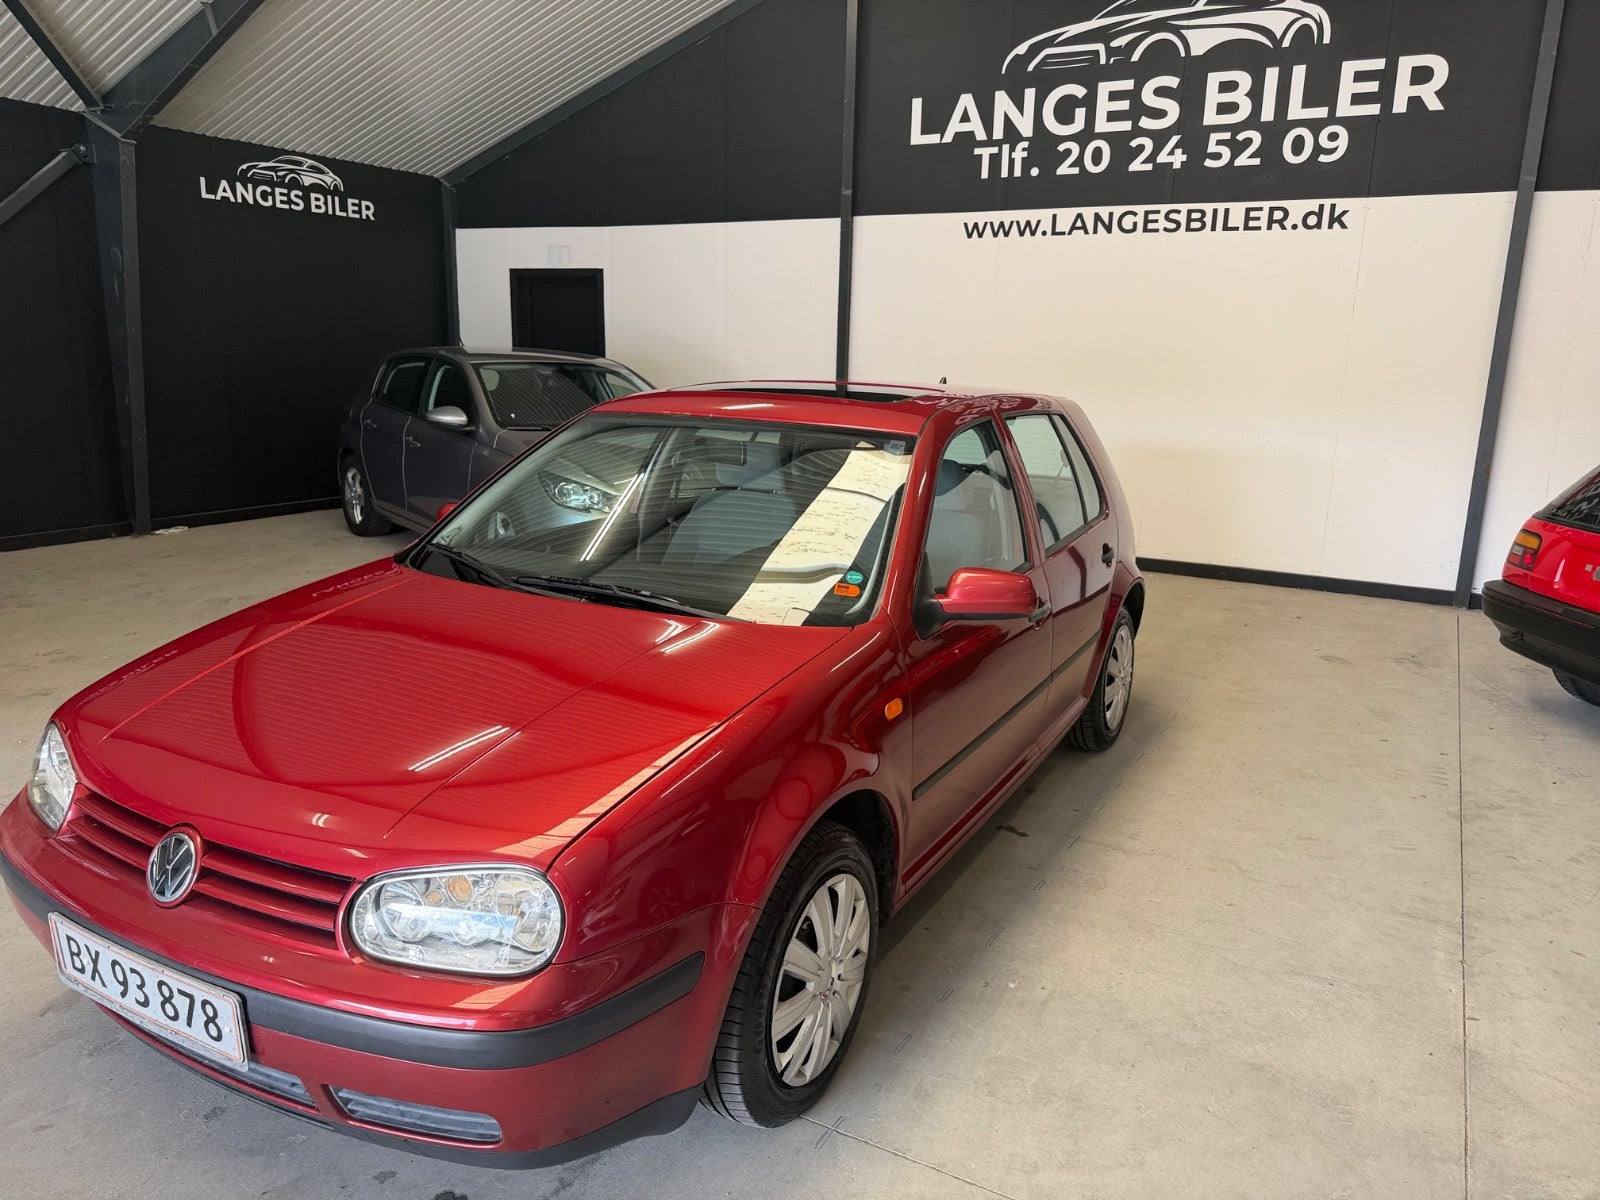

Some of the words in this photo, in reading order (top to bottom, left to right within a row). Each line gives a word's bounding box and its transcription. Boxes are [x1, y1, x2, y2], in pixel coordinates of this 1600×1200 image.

[911, 75, 1181, 145] LANGES
[1202, 53, 1450, 126] BILER
[973, 140, 1040, 180] Tlf.
[1055, 139, 1111, 176] 20
[1127, 134, 1188, 172] 24
[1203, 129, 1262, 168] 52
[1282, 124, 1349, 165] 09
[199, 176, 305, 212] LANGES
[309, 192, 375, 221] BILER
[963, 203, 1350, 239] www.LANGESBILER.dk
[65, 933, 107, 989] BX
[110, 958, 150, 1009] 93
[156, 979, 223, 1043] 878
